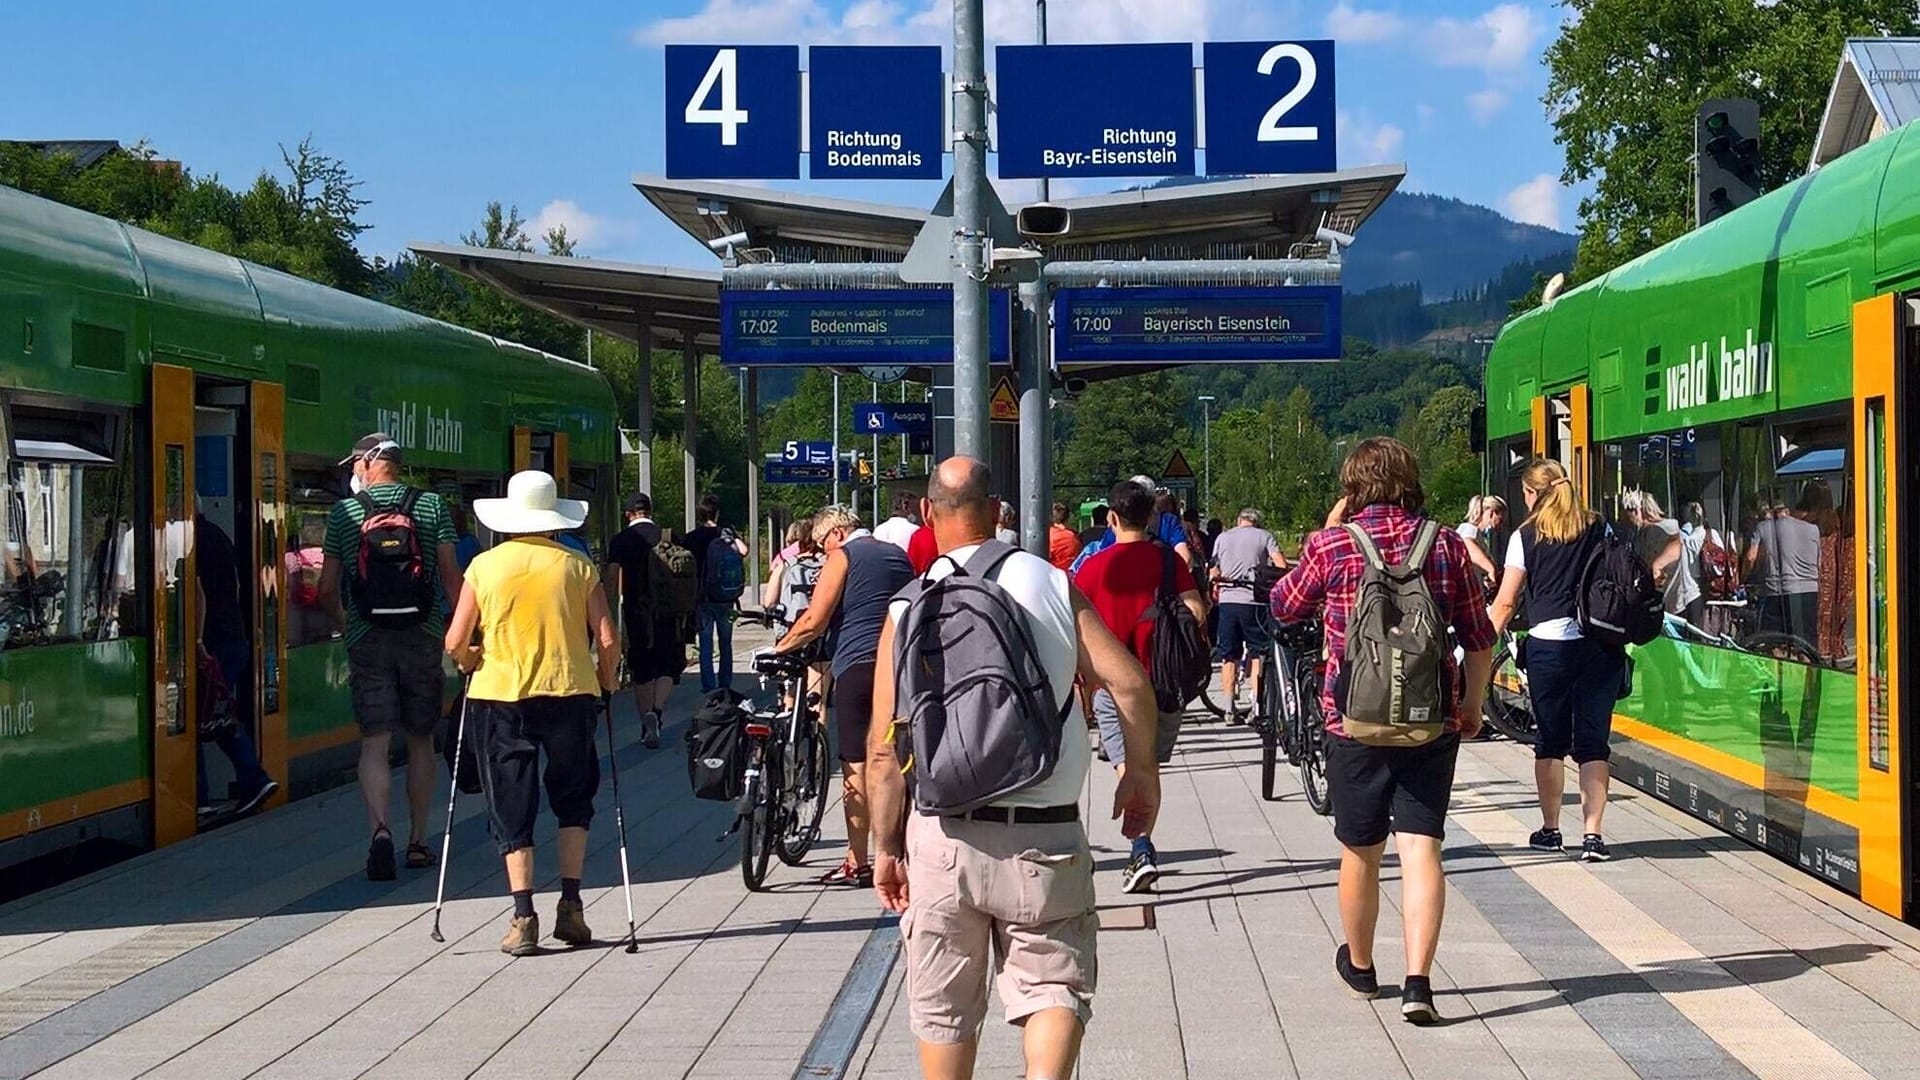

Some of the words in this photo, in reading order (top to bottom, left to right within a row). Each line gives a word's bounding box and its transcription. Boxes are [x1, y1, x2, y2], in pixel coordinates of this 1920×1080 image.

[685, 48, 748, 146] 4
[1257, 43, 1318, 142] 2
[827, 130, 902, 150] Richtung
[1103, 128, 1177, 146] Richtung
[827, 151, 922, 167] Bodenmais
[1043, 149, 1177, 169] Bayr.-Eisenstein
[740, 319, 778, 334] 17:02
[810, 318, 888, 334] Bodenmais
[1072, 317, 1112, 332] 17:00
[1143, 315, 1213, 334] Bayerisch
[1218, 315, 1291, 331] Eisenstein
[1666, 341, 1708, 412] wald
[1719, 328, 1773, 402] bahn
[892, 412, 927, 422] Ausgang
[377, 400, 416, 449] wald
[426, 405, 462, 454] bahn
[784, 441, 799, 460] 5
